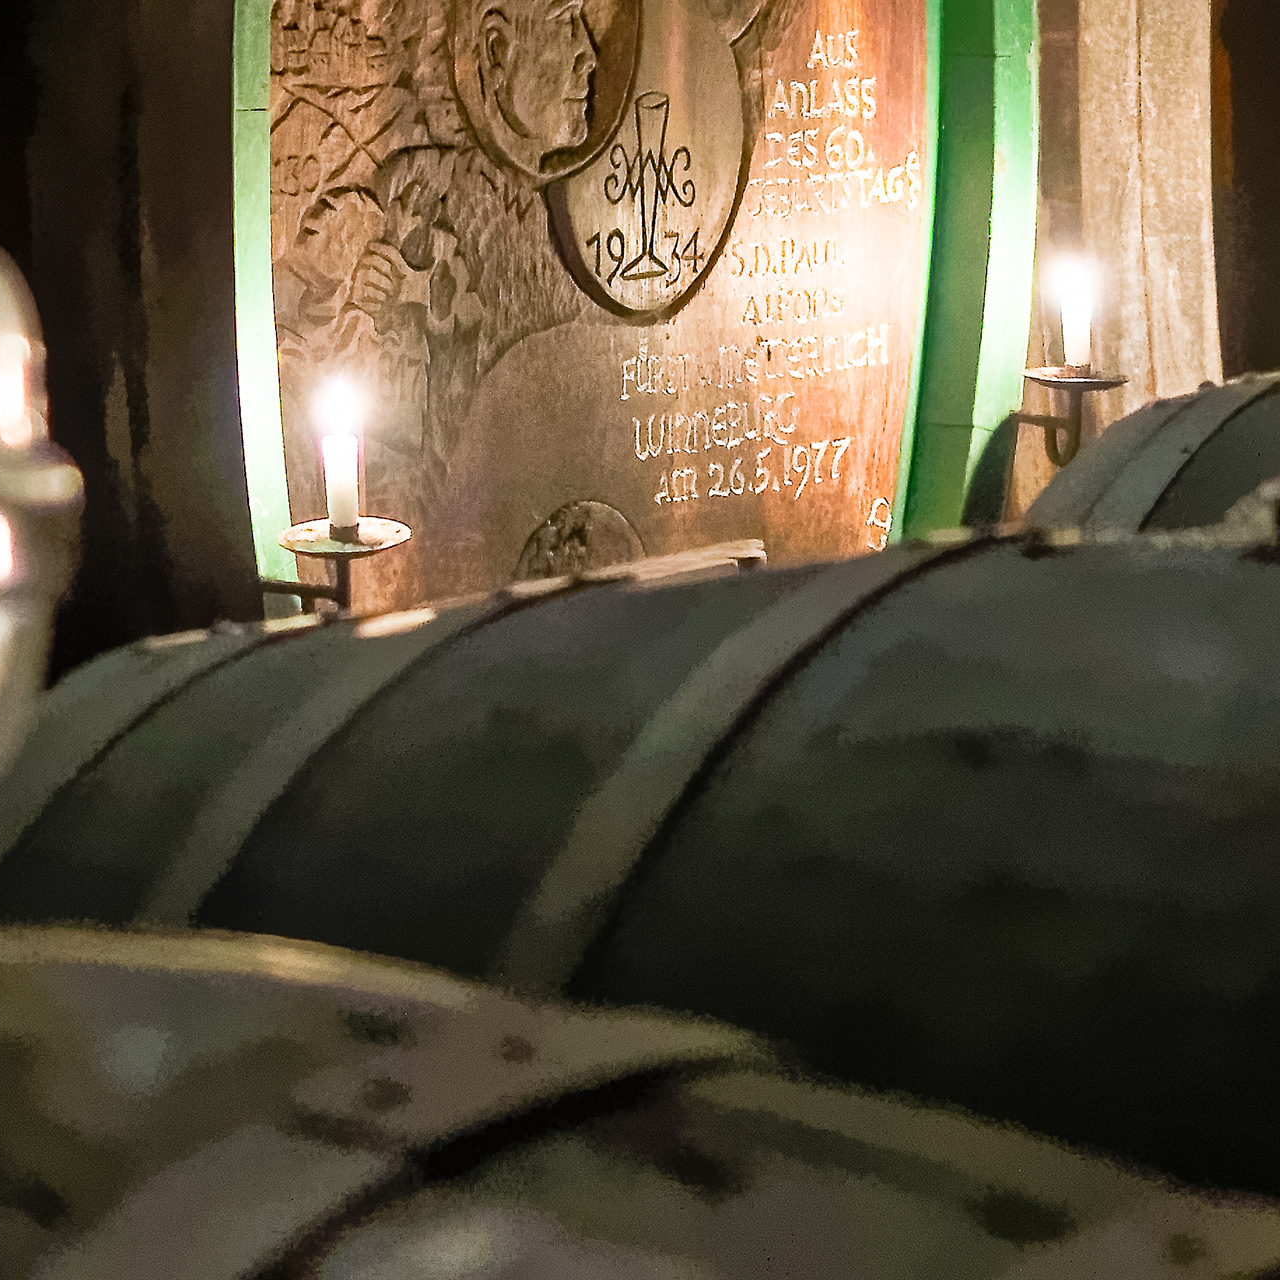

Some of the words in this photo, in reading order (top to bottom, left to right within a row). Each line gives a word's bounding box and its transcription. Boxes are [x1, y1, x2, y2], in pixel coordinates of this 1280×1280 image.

[806, 29, 860, 70] AUS
[763, 128, 820, 170] DES
[708, 435, 854, 501] 26.5.1977
